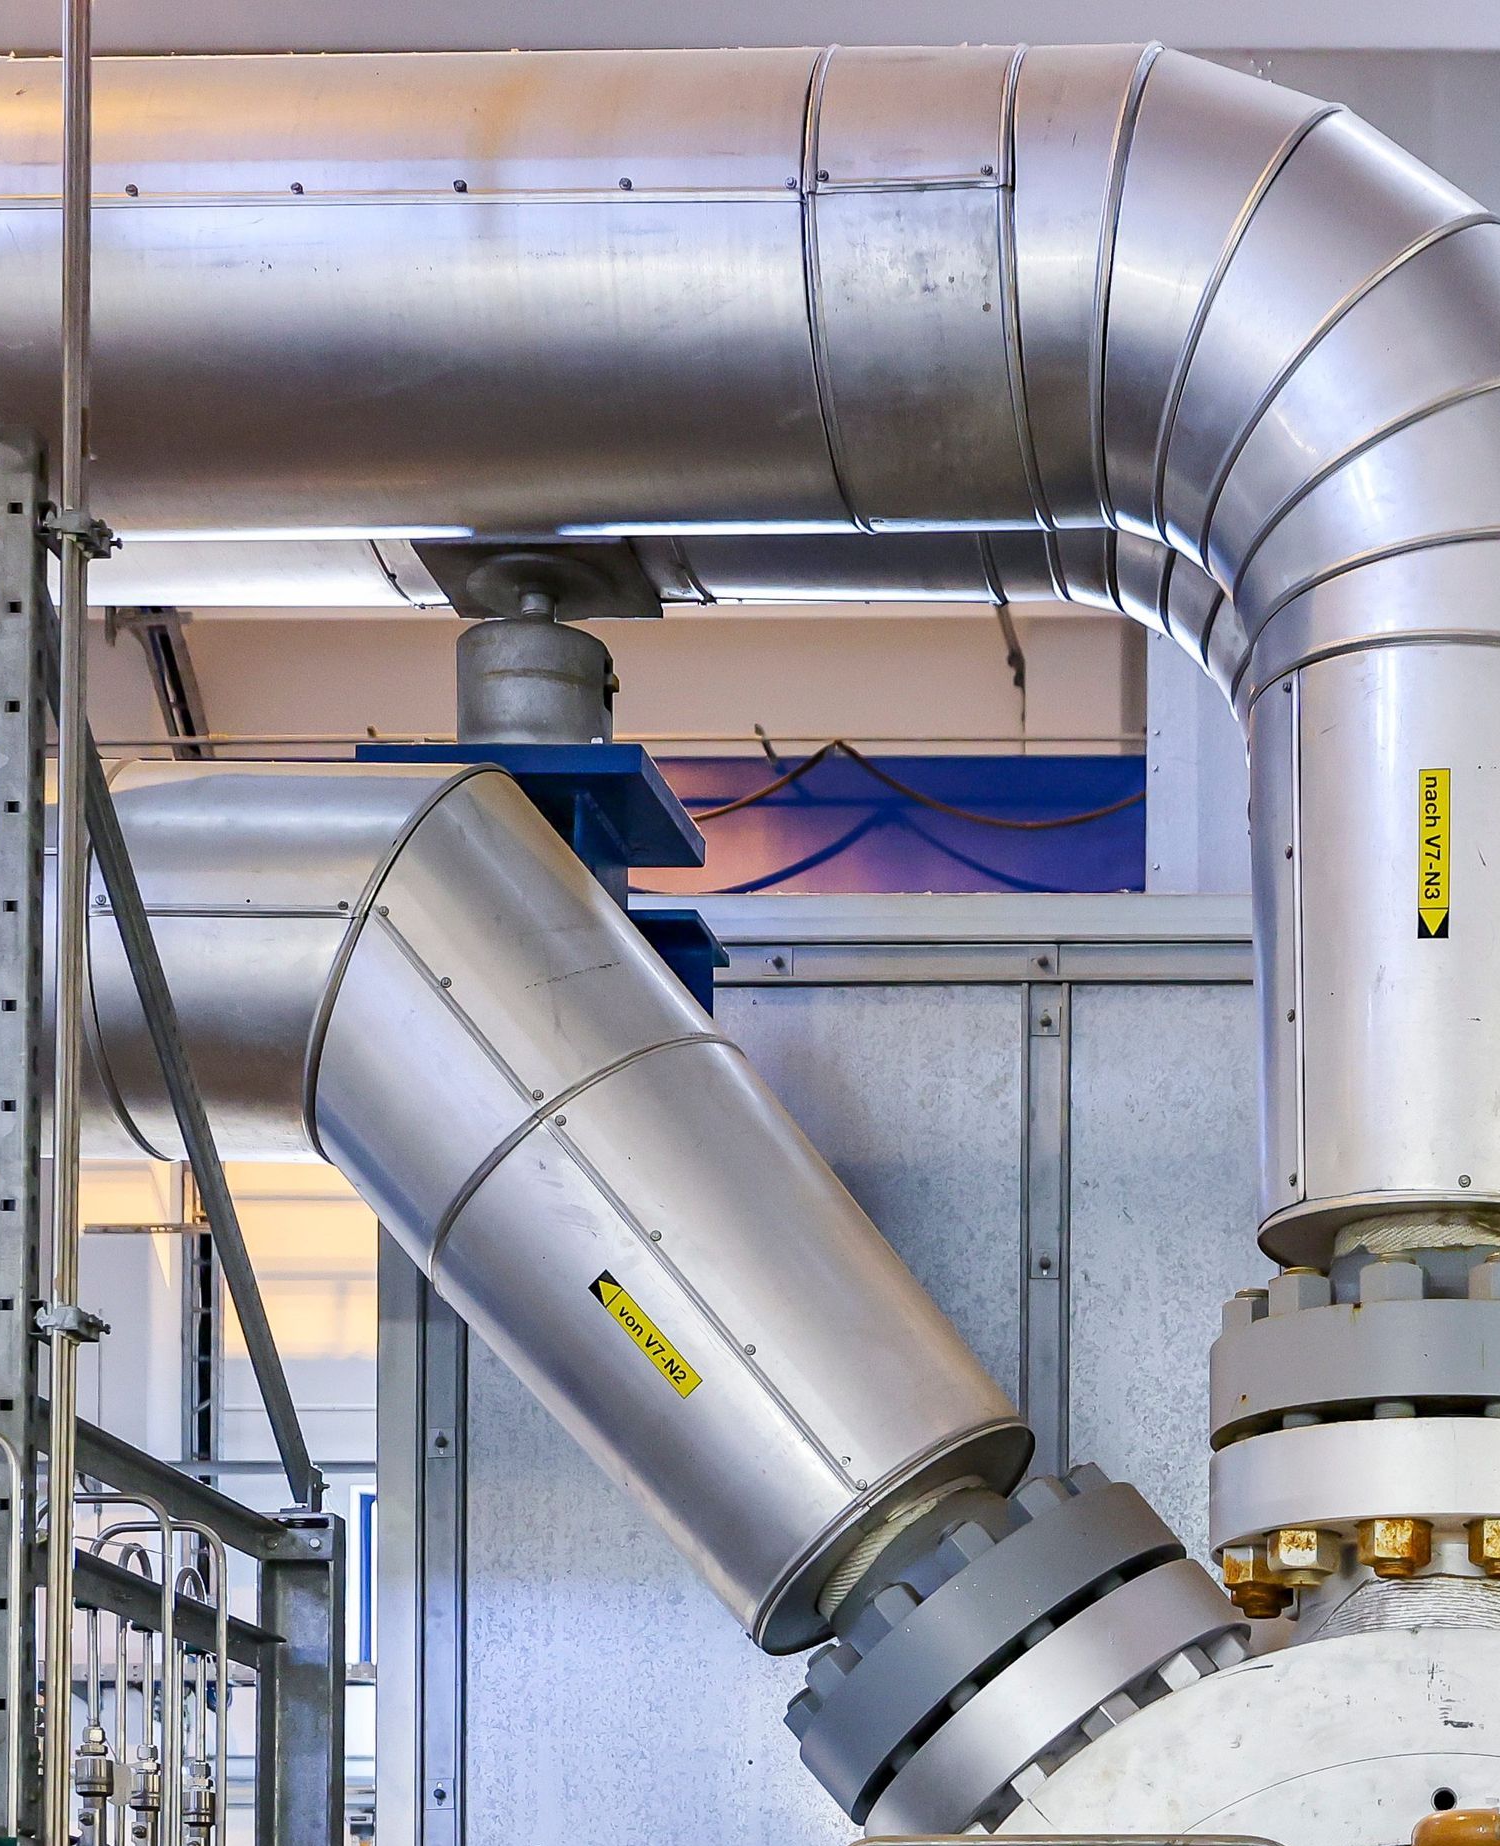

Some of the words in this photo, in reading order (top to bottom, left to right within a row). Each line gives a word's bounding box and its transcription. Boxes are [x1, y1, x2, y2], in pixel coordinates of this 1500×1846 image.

[1425, 775, 1441, 828] nach
[1424, 834, 1441, 900] V7-N3
[618, 1306, 644, 1338] von
[644, 1333, 688, 1386] V7-N2
